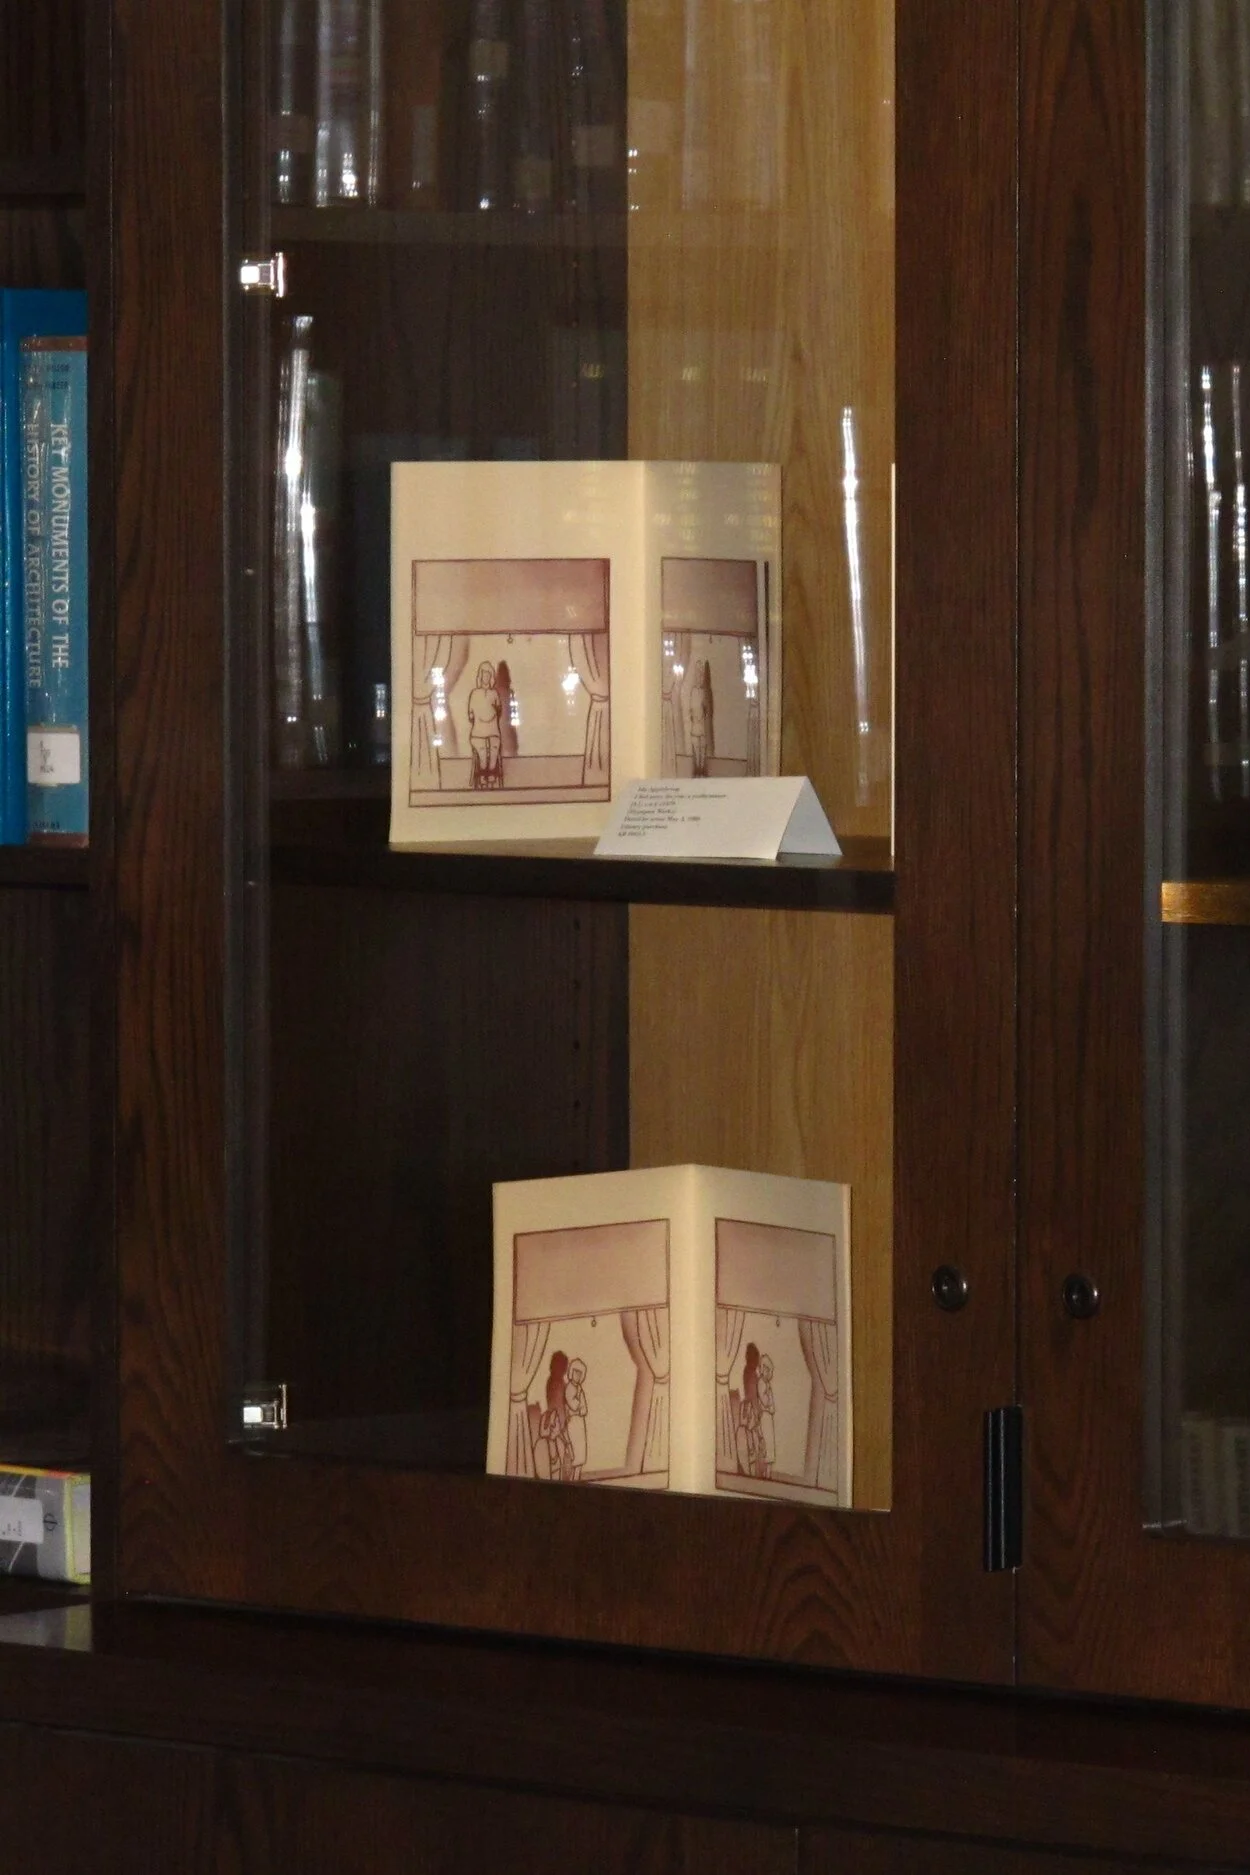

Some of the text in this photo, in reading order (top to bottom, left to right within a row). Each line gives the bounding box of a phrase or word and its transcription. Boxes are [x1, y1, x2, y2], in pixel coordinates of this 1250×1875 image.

[26, 422, 42, 688] HISTORY OF ARCHITECTURE
[50, 423, 70, 669] KEY MONUMENTS OF THE
